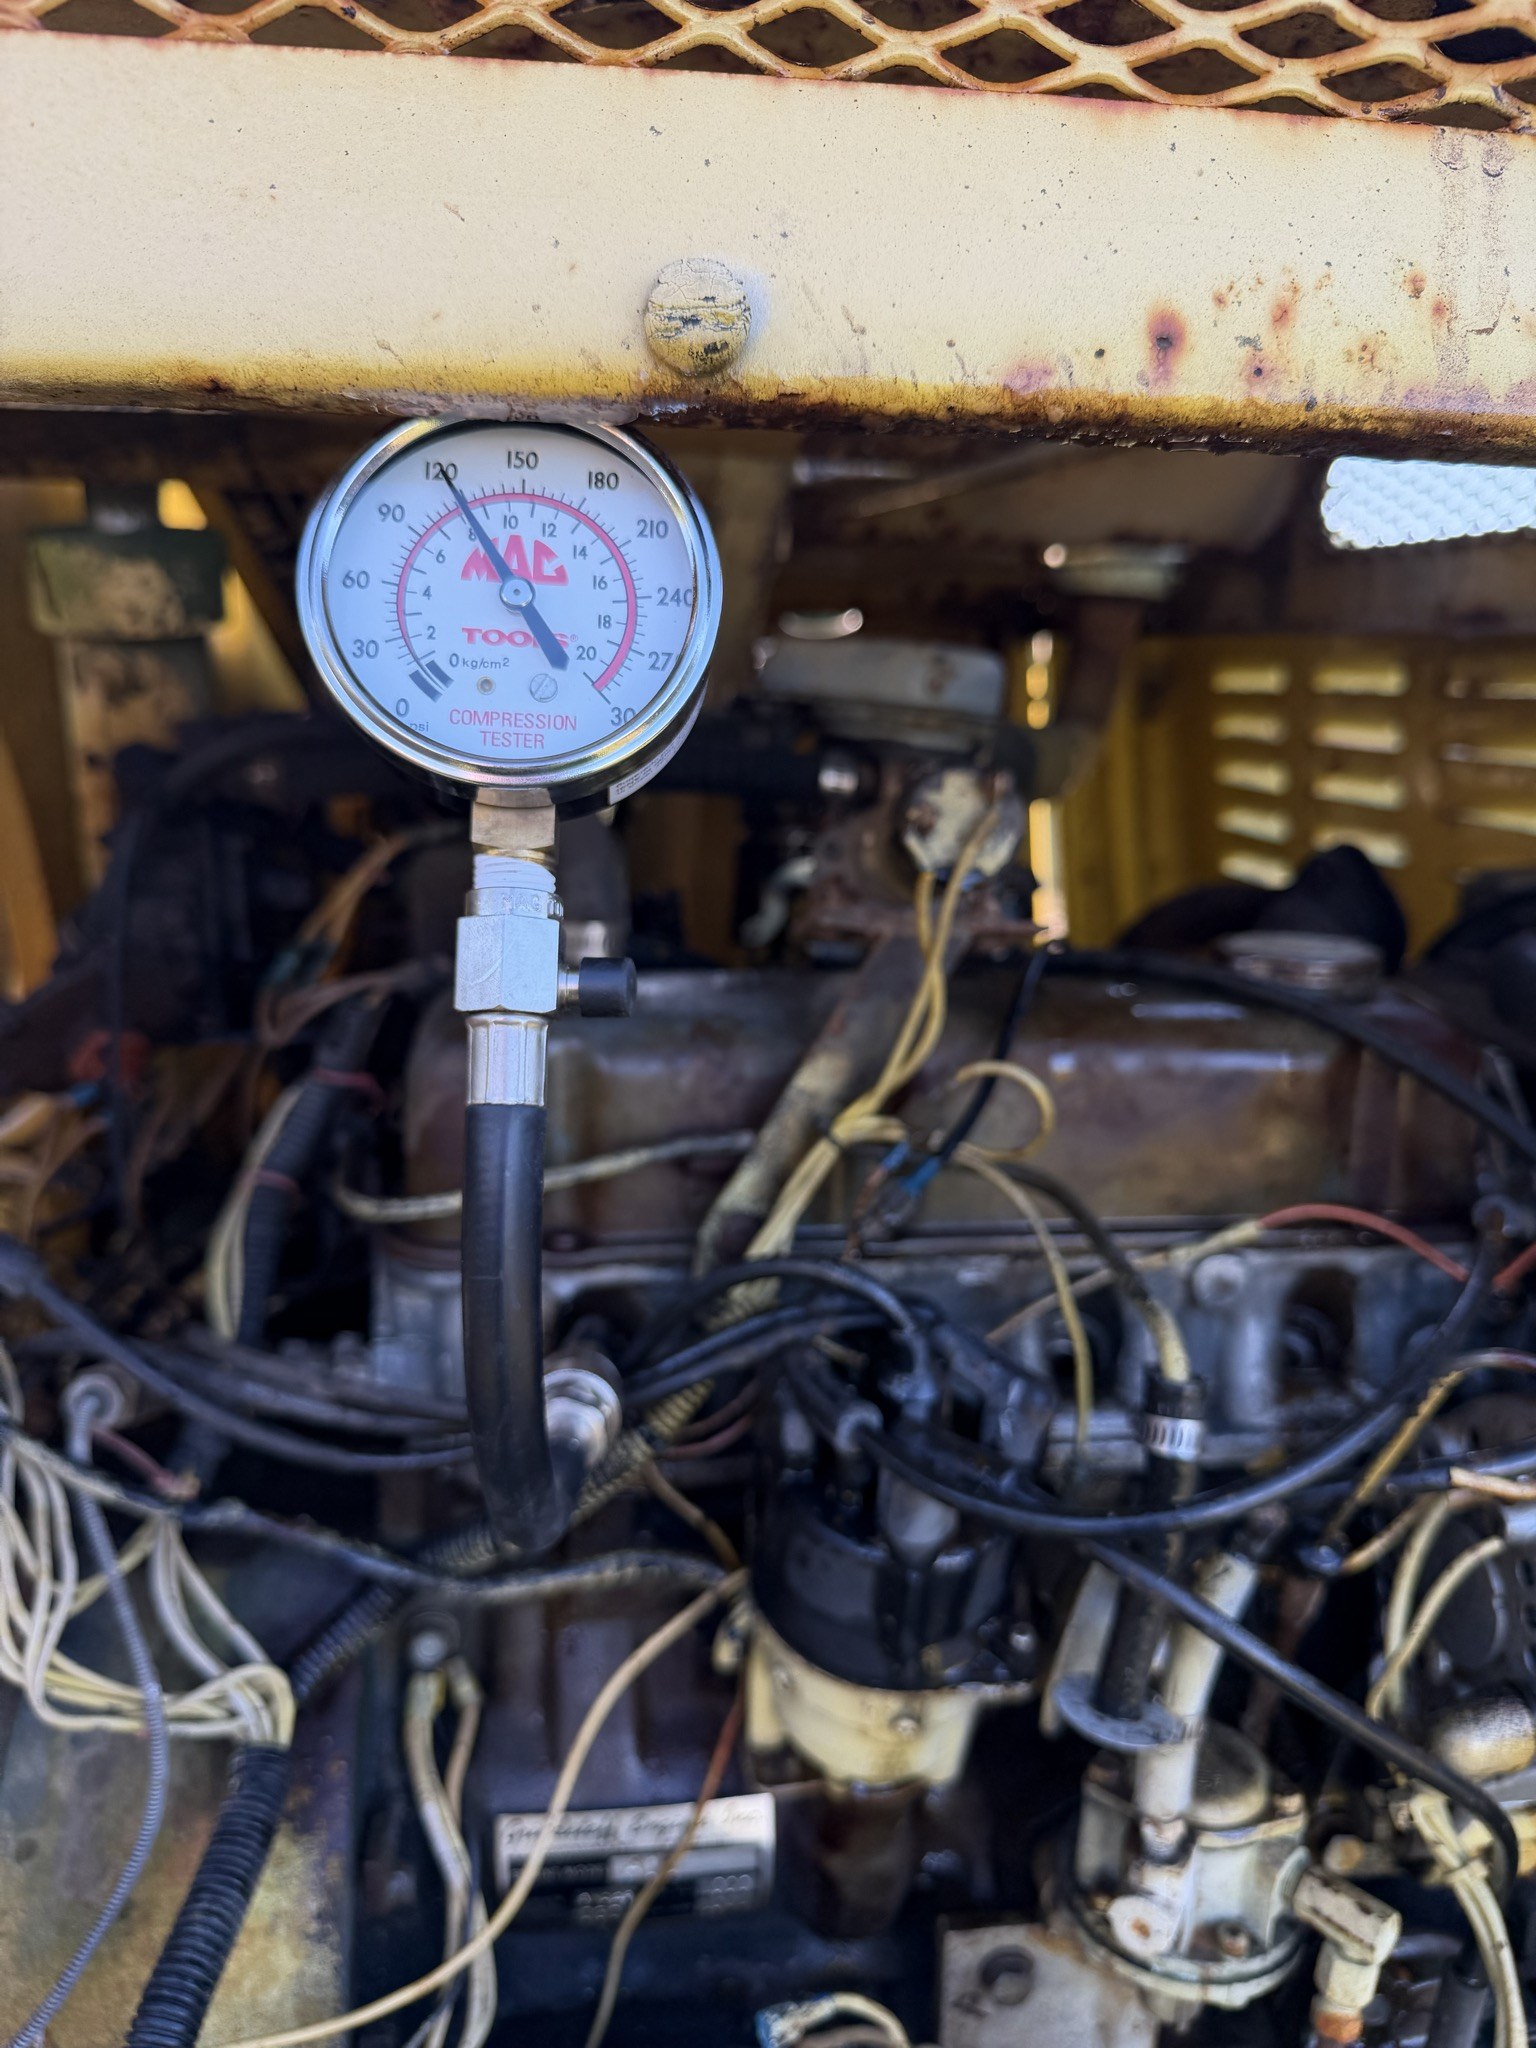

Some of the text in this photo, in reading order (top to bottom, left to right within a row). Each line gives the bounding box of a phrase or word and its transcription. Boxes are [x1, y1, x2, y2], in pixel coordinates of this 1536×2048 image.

[506, 450, 539, 470] 150
[425, 461, 458, 481] 120
[587, 471, 619, 490] 180
[378, 503, 405, 523] 90
[503, 515, 519, 529] 10
[541, 523, 557, 538] 12
[636, 518, 669, 539] 210
[436, 549, 446, 564] 6
[460, 534, 569, 586] MAC
[573, 545, 588, 560] 14
[342, 570, 370, 590] 60
[592, 575, 608, 590] 16
[422, 585, 433, 600] 4
[598, 614, 612, 629] 18
[427, 625, 436, 640] 2
[352, 638, 380, 660] 30
[576, 645, 598, 662] 20
[648, 651, 674, 672] 27
[395, 698, 410, 718] 0
[449, 708, 577, 731] COMPRESSION
[480, 730, 545, 749] TESTER
